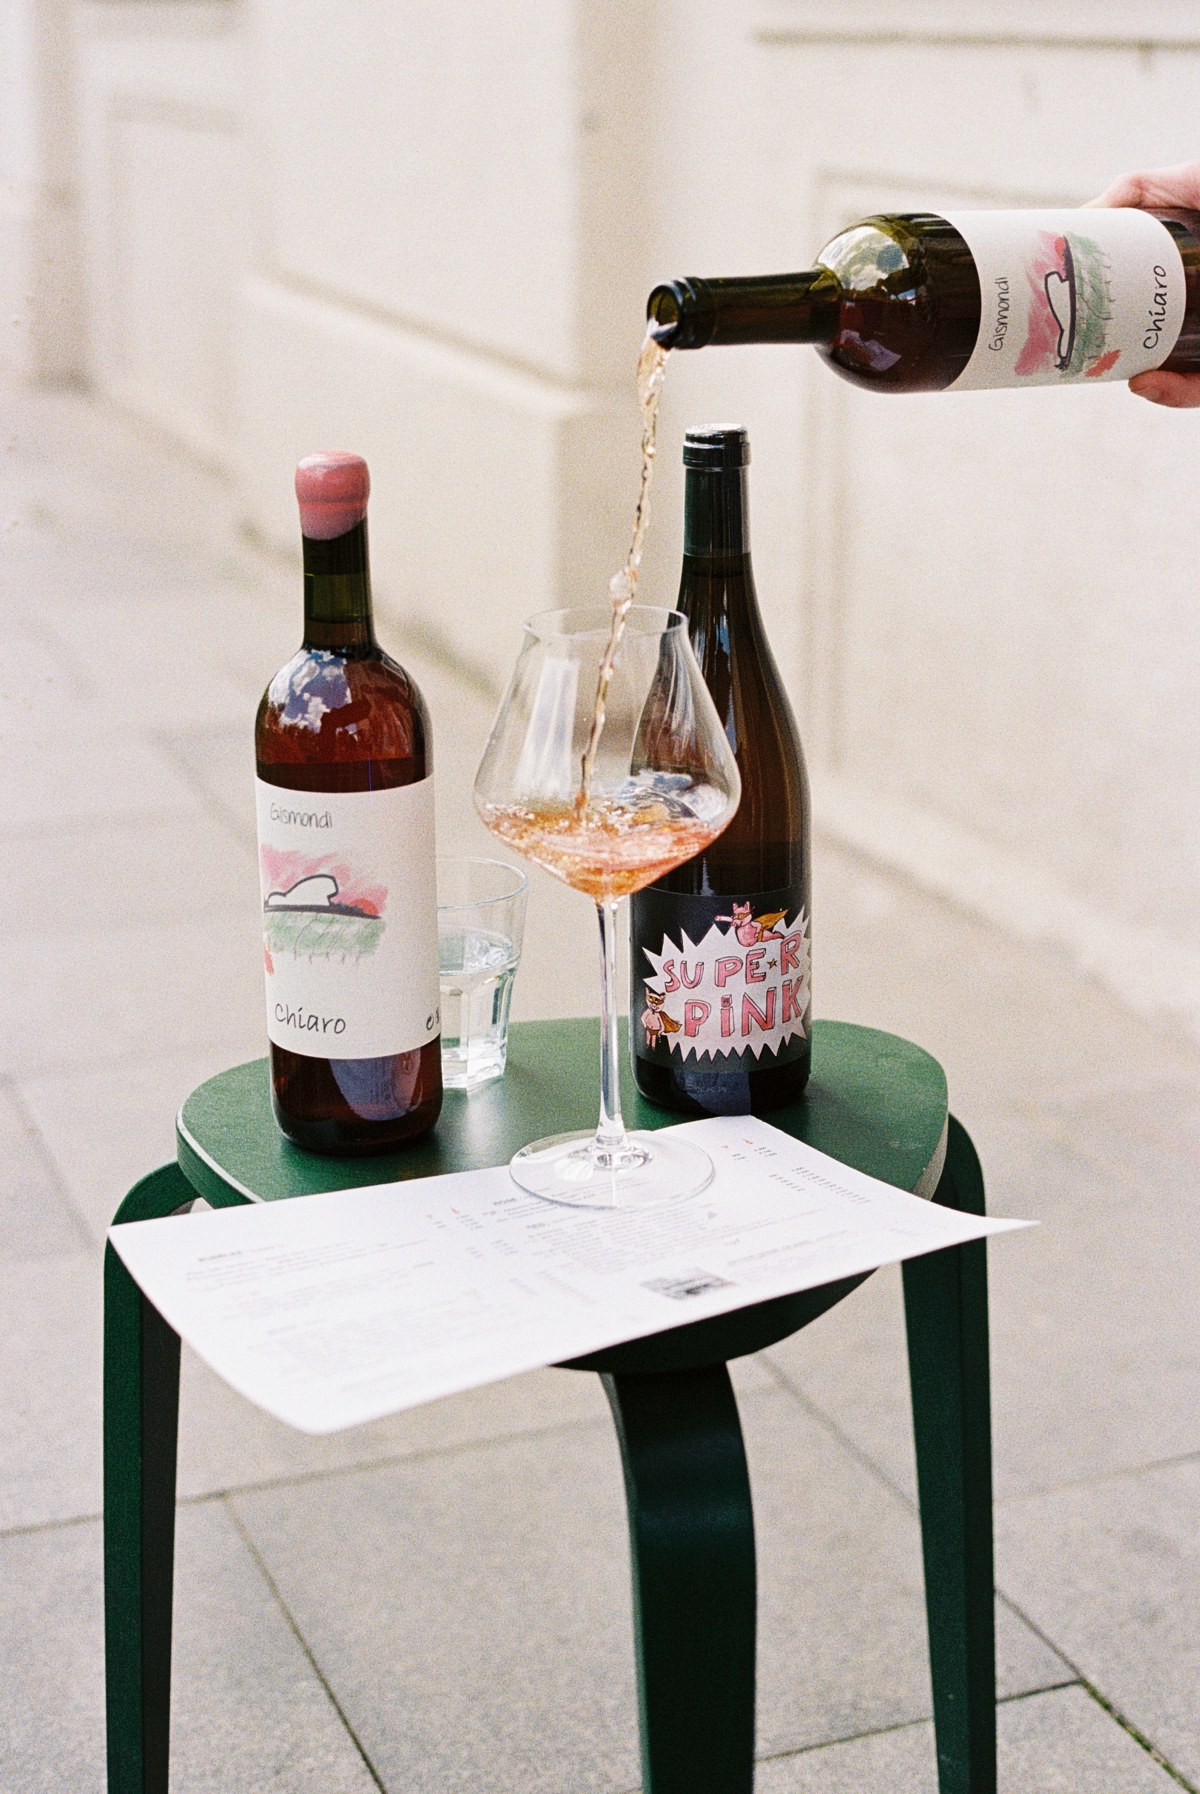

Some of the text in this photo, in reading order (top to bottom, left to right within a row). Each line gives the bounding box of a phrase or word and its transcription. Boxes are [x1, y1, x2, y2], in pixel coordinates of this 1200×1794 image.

[987, 276, 1011, 352] Gismondi
[1142, 265, 1168, 350] Chiaro
[269, 802, 333, 829] Gismondi
[274, 1003, 347, 1035] Chiaro
